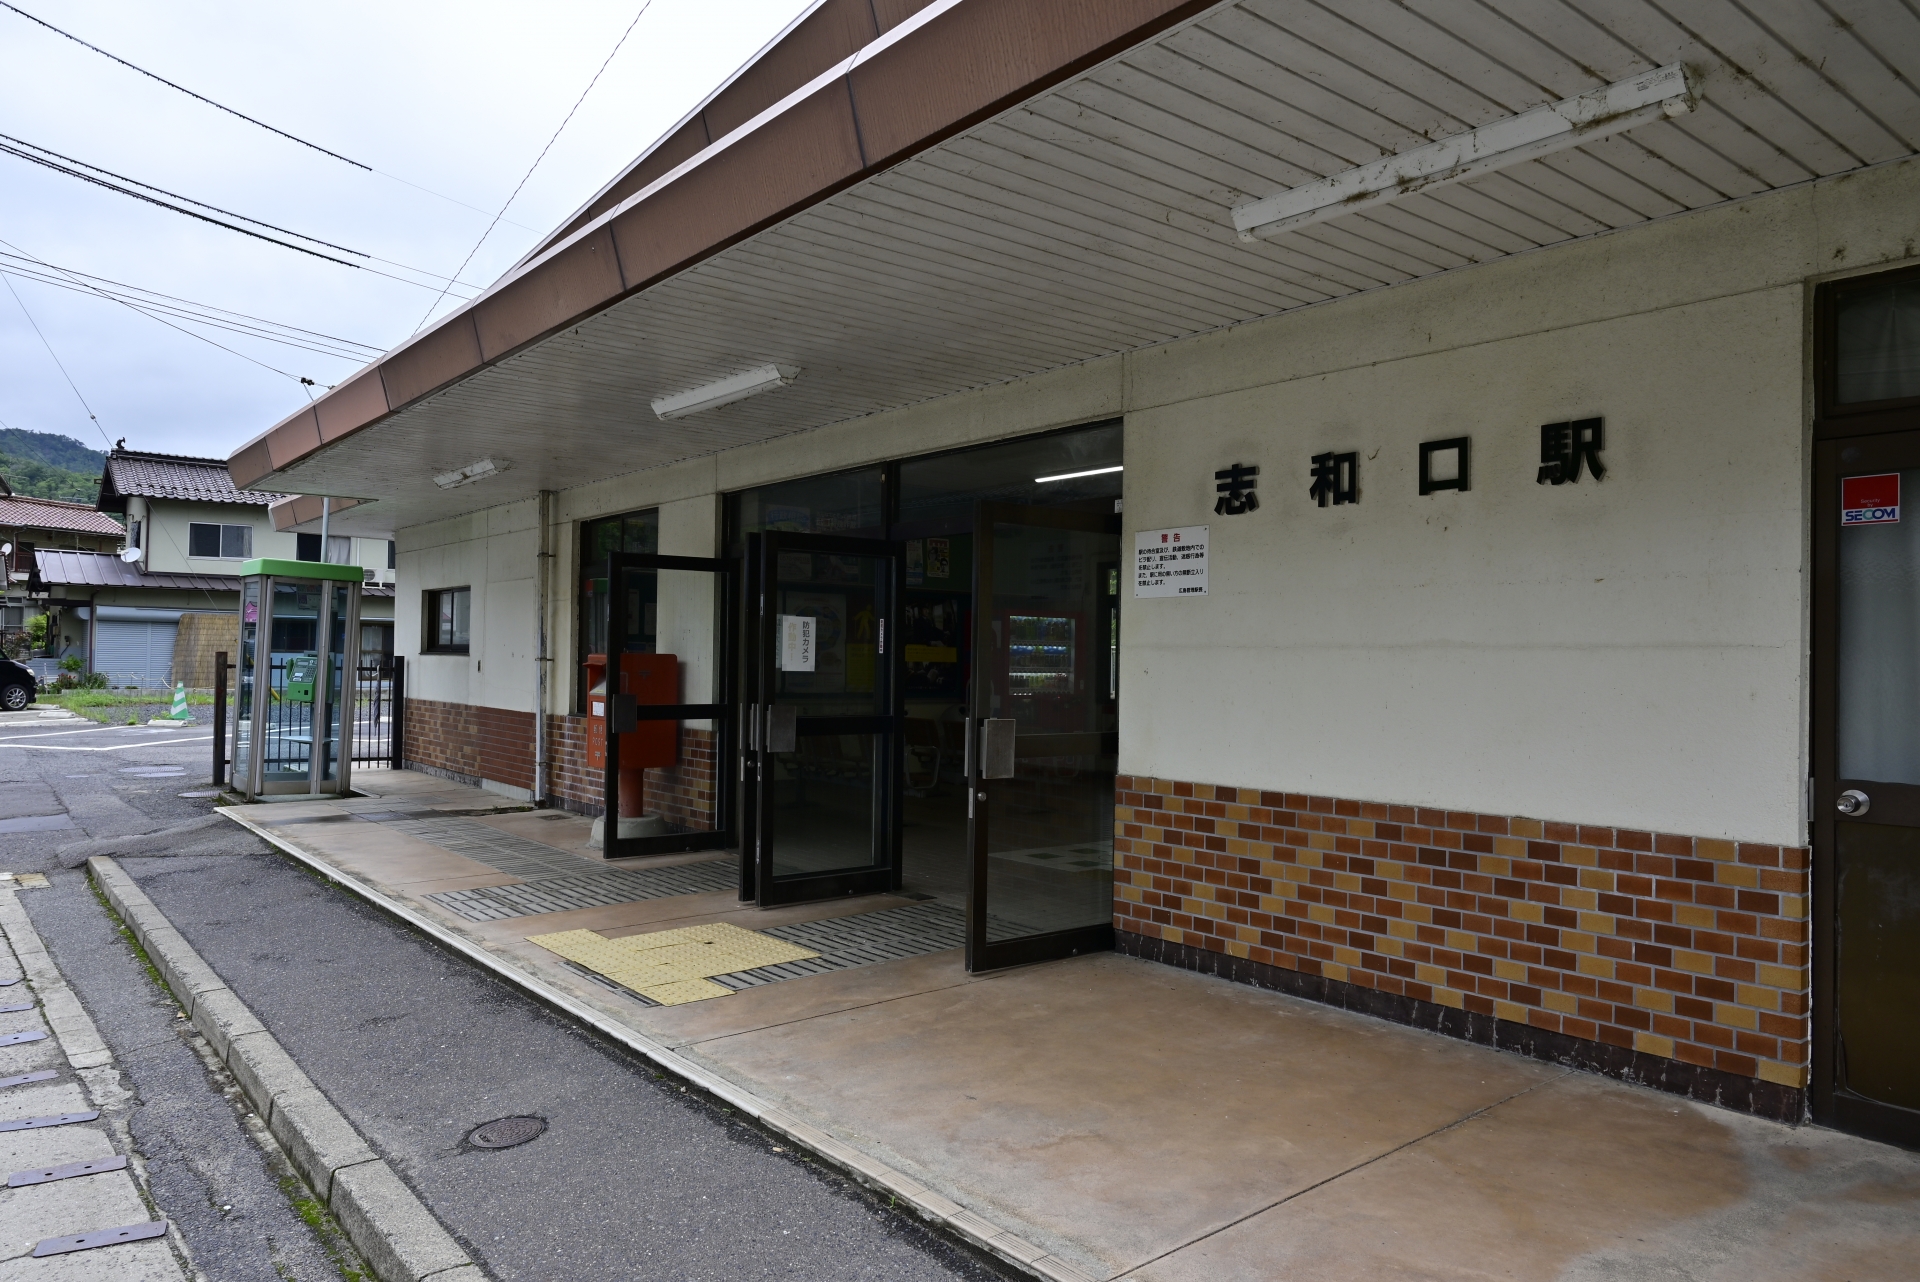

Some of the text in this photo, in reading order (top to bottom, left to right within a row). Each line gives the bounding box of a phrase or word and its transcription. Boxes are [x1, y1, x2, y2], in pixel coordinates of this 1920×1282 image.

[1214, 417, 1607, 516] 志和口駅
[1845, 508, 1896, 521] SECOM
[1161, 533, 1181, 543] 警告
[802, 621, 810, 663] 防犯カメラ
[592, 737, 603, 746] POST
